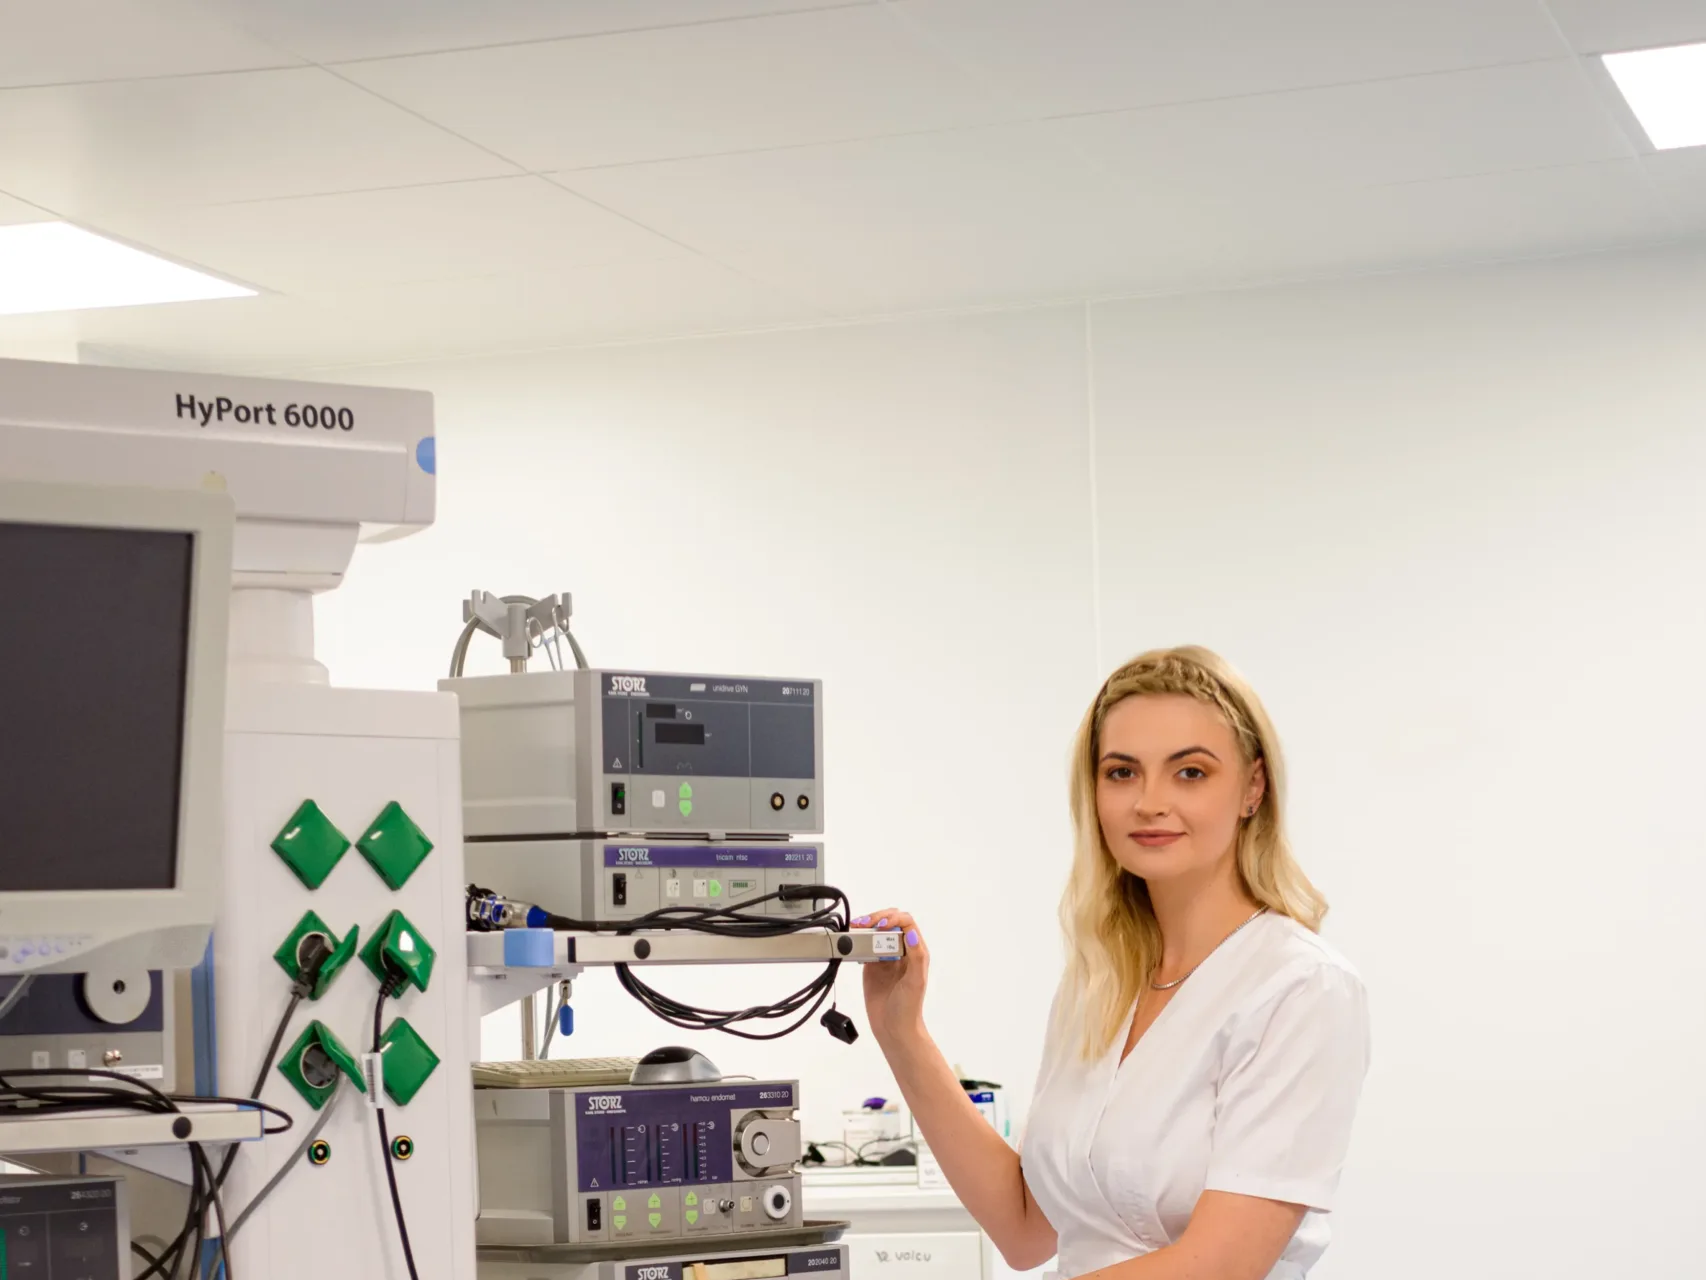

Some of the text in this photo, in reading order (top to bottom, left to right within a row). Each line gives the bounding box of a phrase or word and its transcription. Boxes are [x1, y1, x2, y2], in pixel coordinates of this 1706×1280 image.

[175, 393, 355, 431] HyPort 6000
[611, 675, 646, 692] STORZ
[735, 685, 749, 693] GYN
[618, 847, 649, 861] STORZ
[716, 853, 734, 861] tricam
[588, 1095, 622, 1110] STORZ
[711, 1093, 736, 1101] endomat
[781, 1090, 789, 1098] 20
[637, 1266, 669, 1280] STORZ
